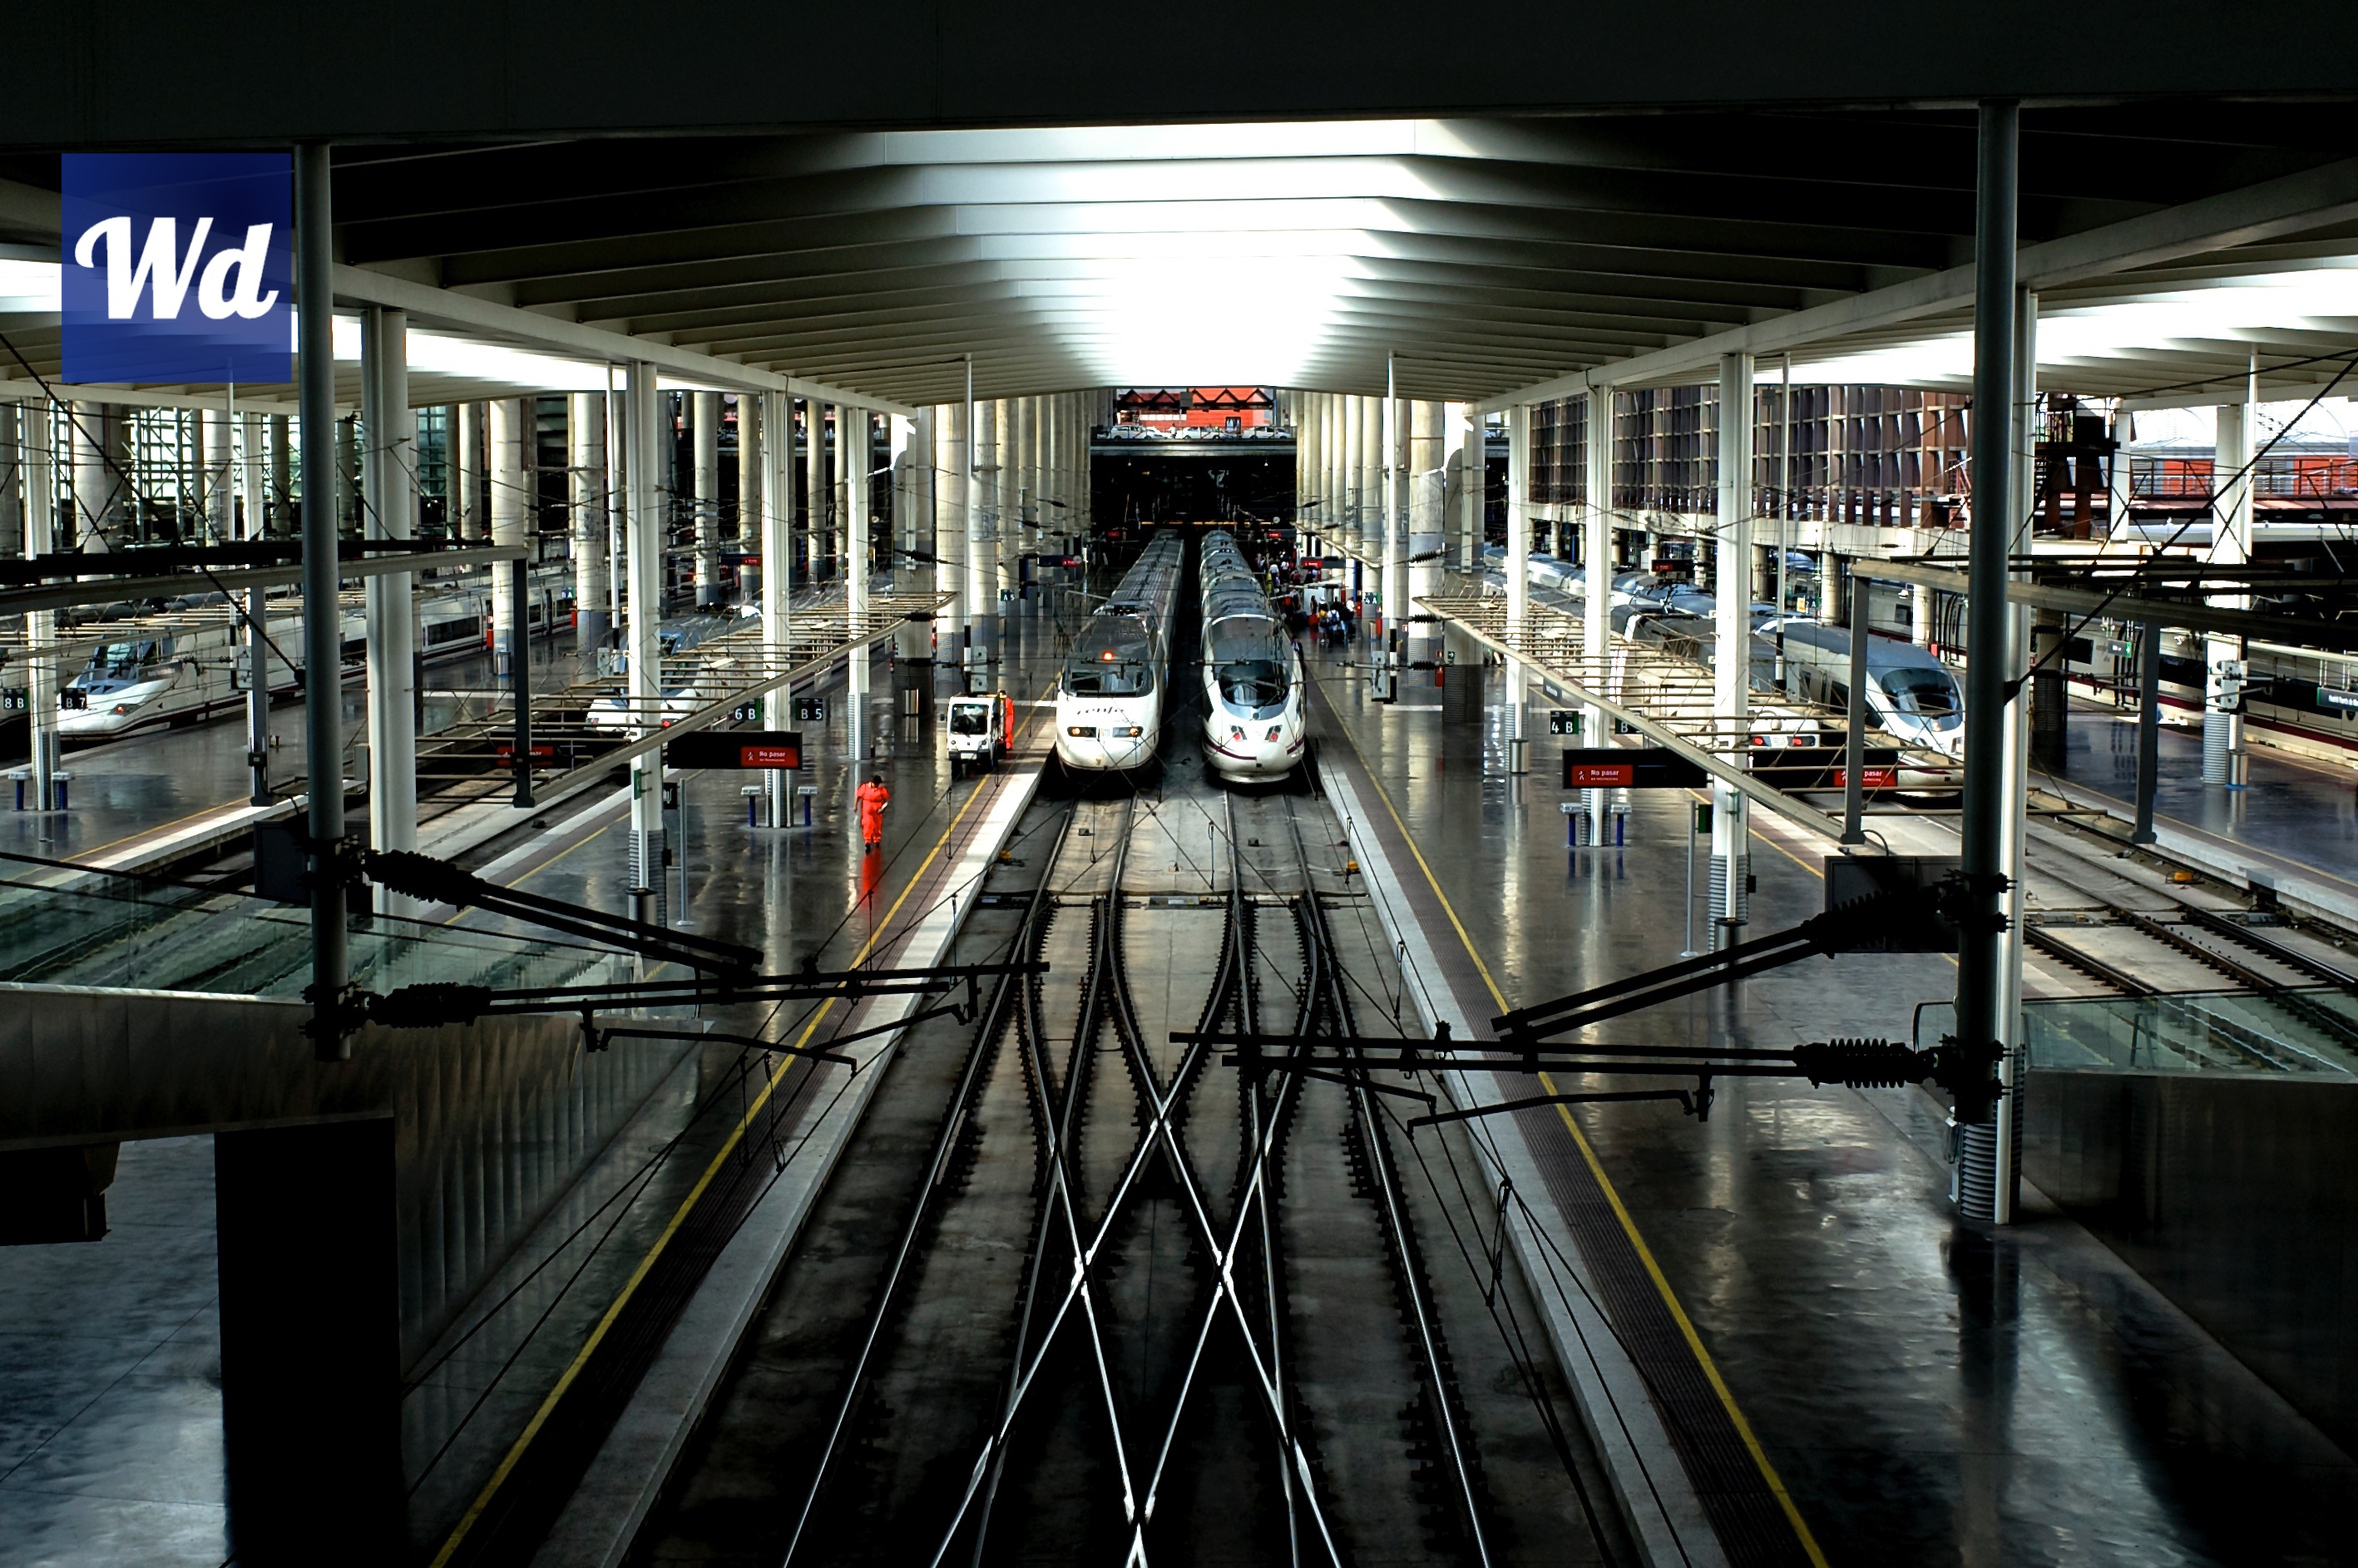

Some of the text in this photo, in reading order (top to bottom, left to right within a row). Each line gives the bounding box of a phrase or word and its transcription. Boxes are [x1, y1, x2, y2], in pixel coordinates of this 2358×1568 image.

[4, 698, 24, 709] 8 B
[67, 698, 86, 709] B 7
[734, 708, 756, 720] 6 B
[801, 708, 823, 720] B 5
[1551, 721, 1574, 734] 4 B
[1620, 721, 1629, 733] B
